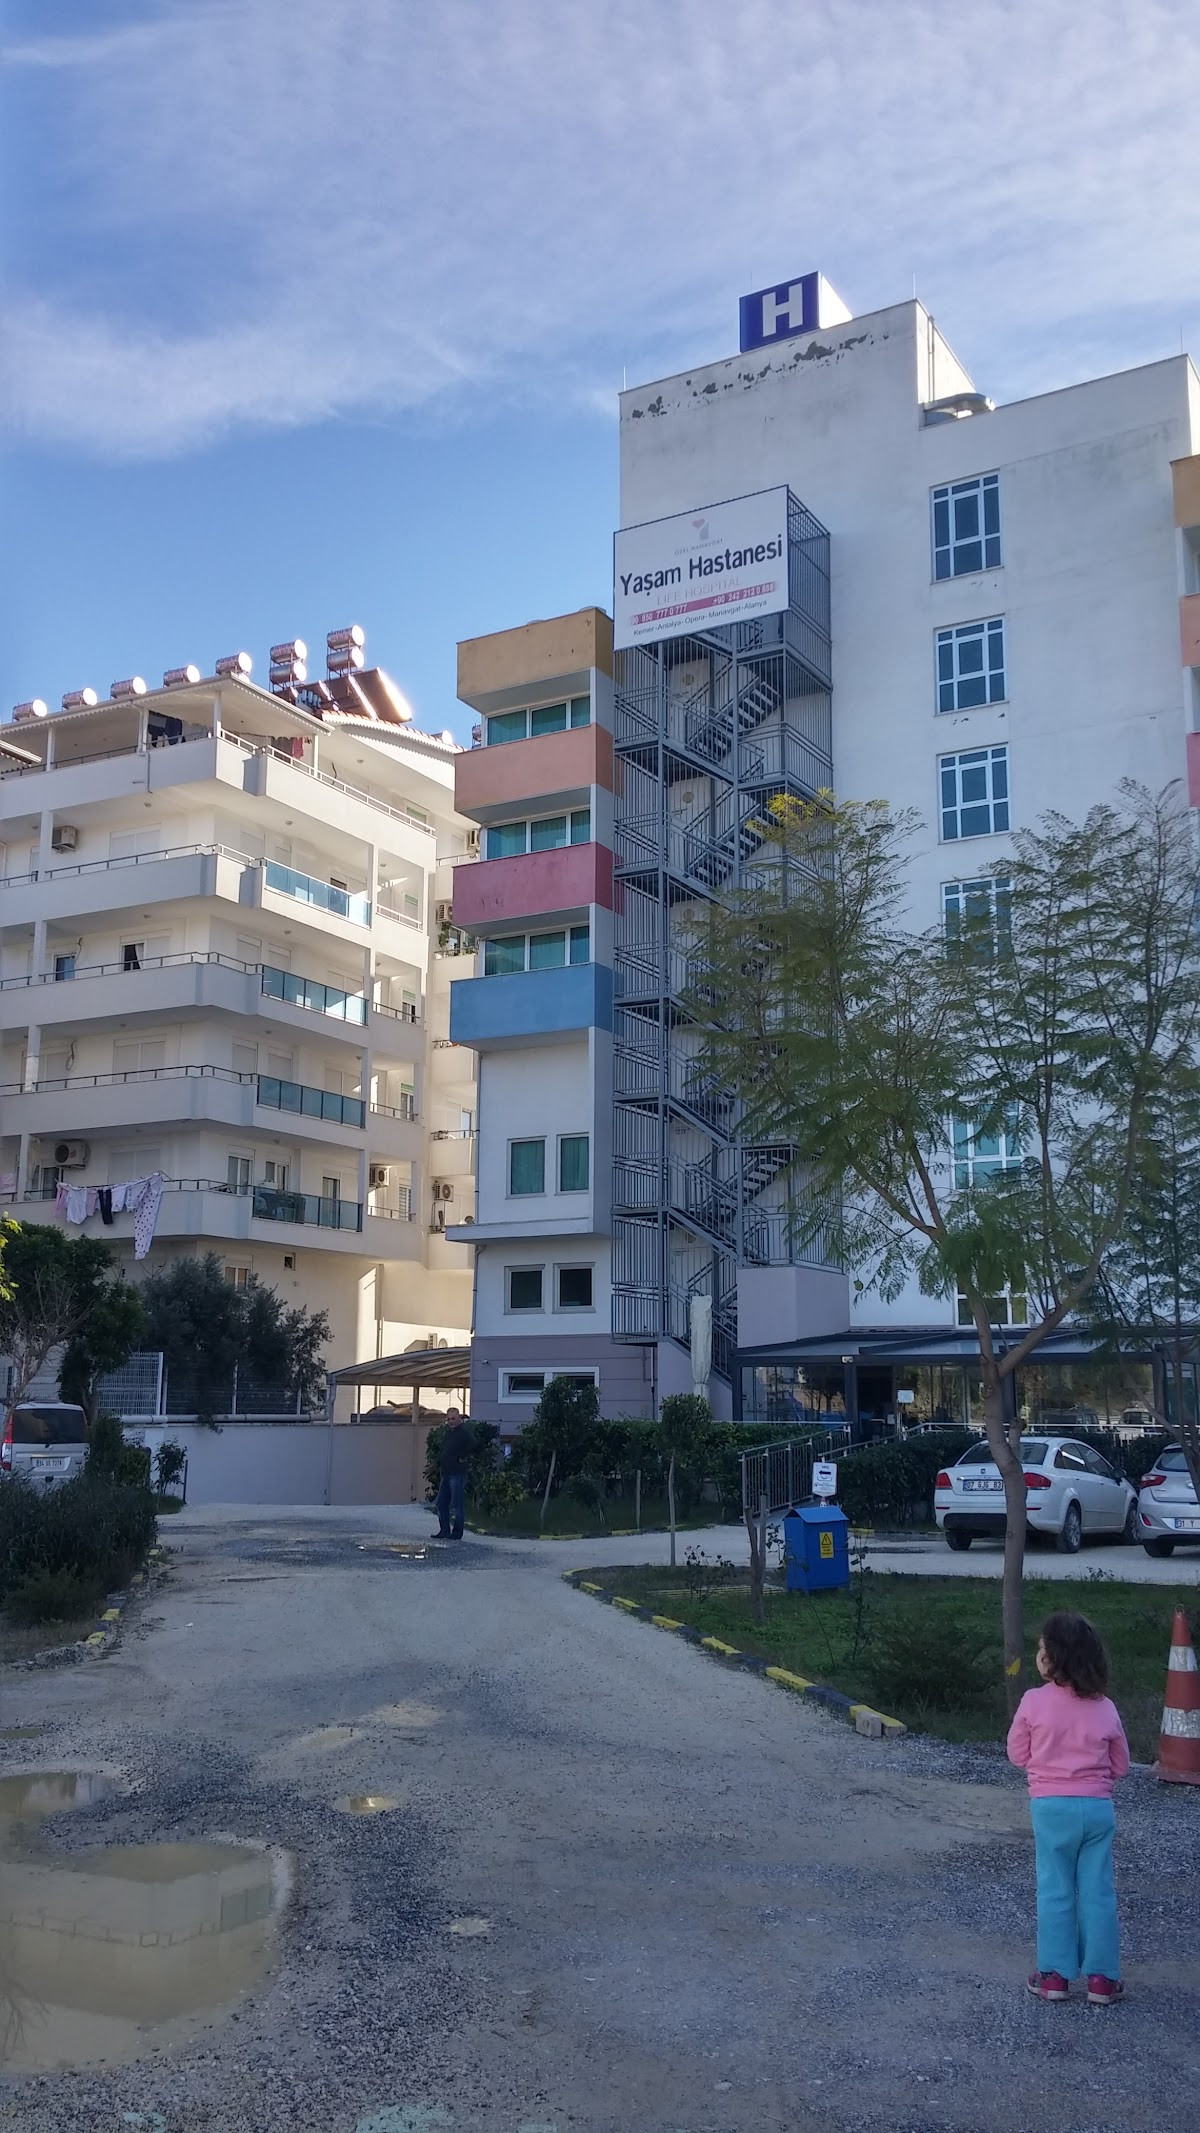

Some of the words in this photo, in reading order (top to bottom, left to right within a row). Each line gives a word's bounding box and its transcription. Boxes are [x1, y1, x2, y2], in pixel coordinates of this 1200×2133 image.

[762, 282, 803, 337] H
[620, 565, 681, 597] Yaşam
[689, 534, 783, 580] Hastanesi
[657, 591, 680, 606] LIFE
[685, 577, 741, 599] HOSPITAL
